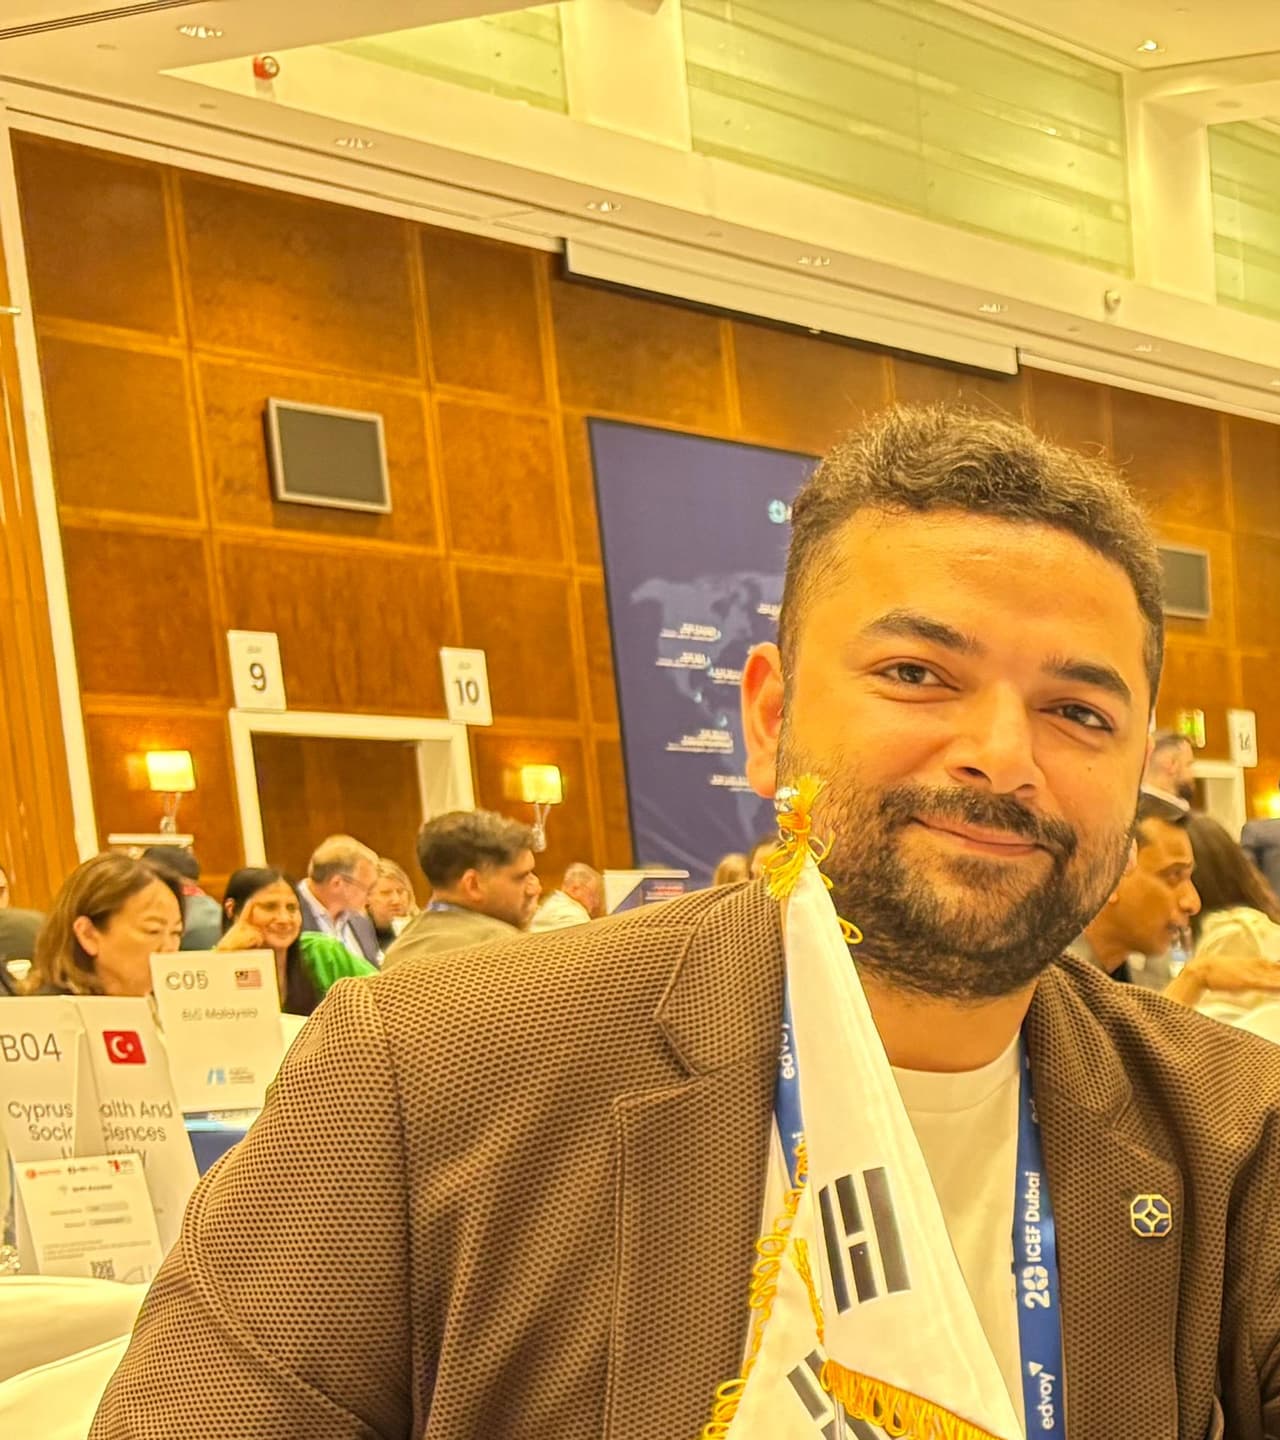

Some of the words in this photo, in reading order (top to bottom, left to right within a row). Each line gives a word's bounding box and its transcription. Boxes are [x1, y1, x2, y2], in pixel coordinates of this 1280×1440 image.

[250, 662, 267, 692] 9
[455, 679, 480, 705] 10
[1, 1032, 61, 1063] B04
[8, 1101, 73, 1122] Cyprus
[140, 1100, 173, 1119] And
[1025, 1171, 1041, 1223] Dubai
[1026, 1226, 1042, 1262] ICEF
[1038, 1372, 1056, 1430] edvoy
